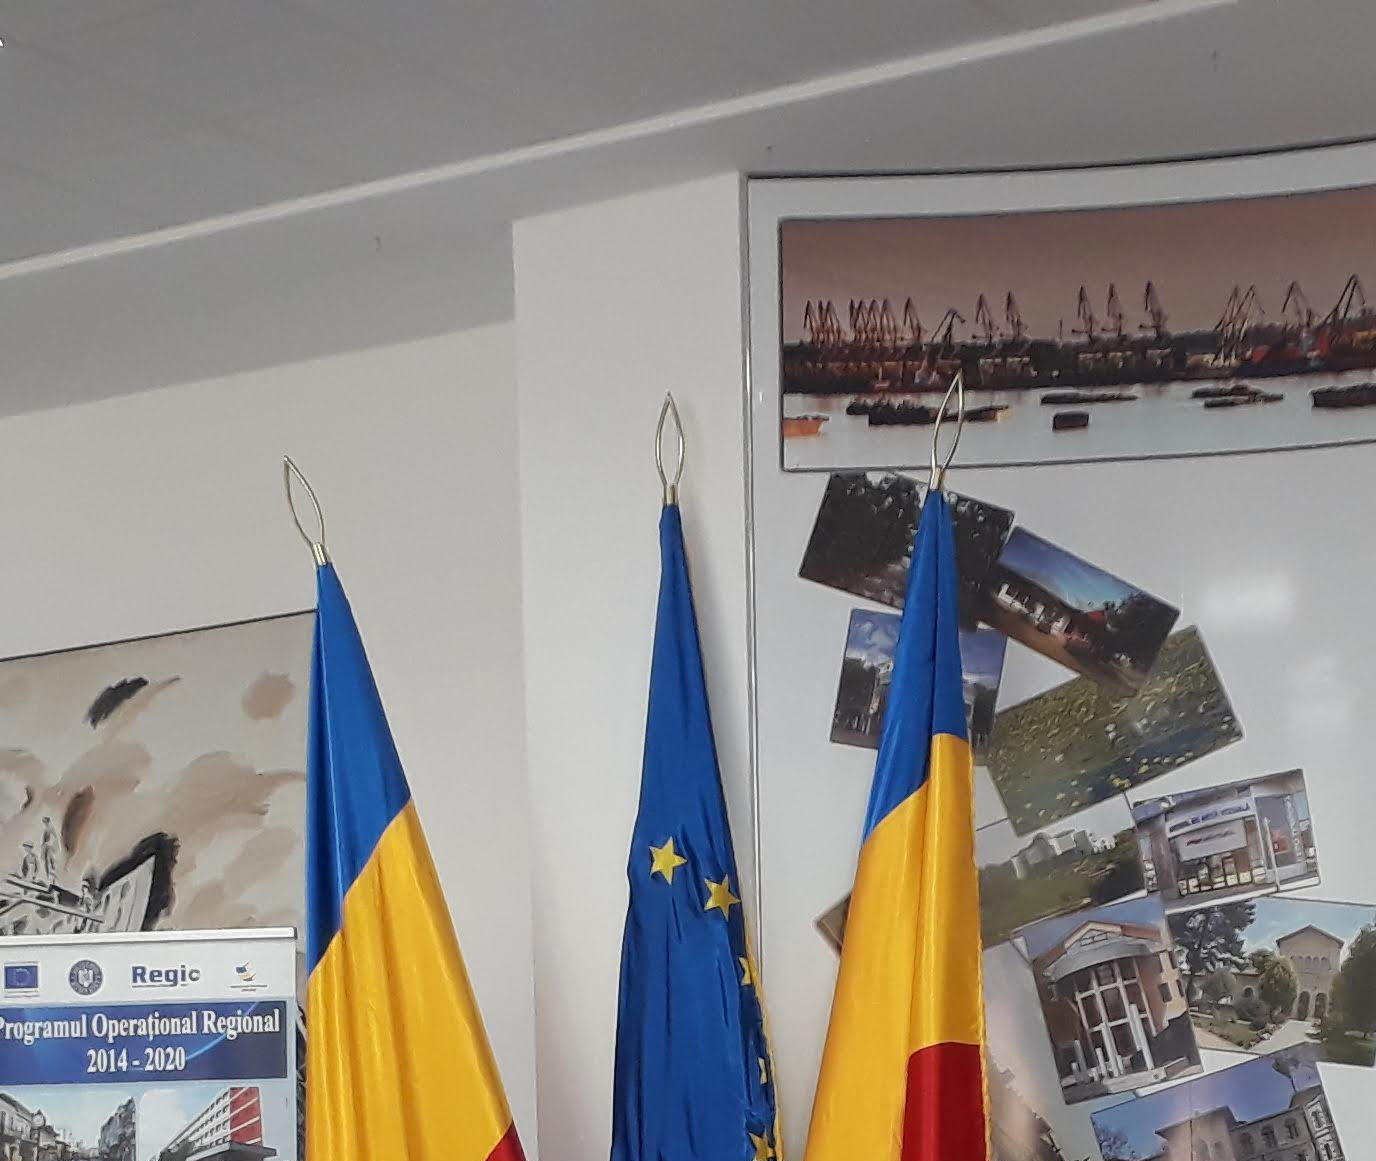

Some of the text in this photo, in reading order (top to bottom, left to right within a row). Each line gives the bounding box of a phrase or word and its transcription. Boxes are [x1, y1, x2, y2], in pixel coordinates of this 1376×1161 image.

[202, 1009, 281, 1039] Regional
[86, 1049, 128, 1073] 2014
[144, 1047, 187, 1071] 2020
